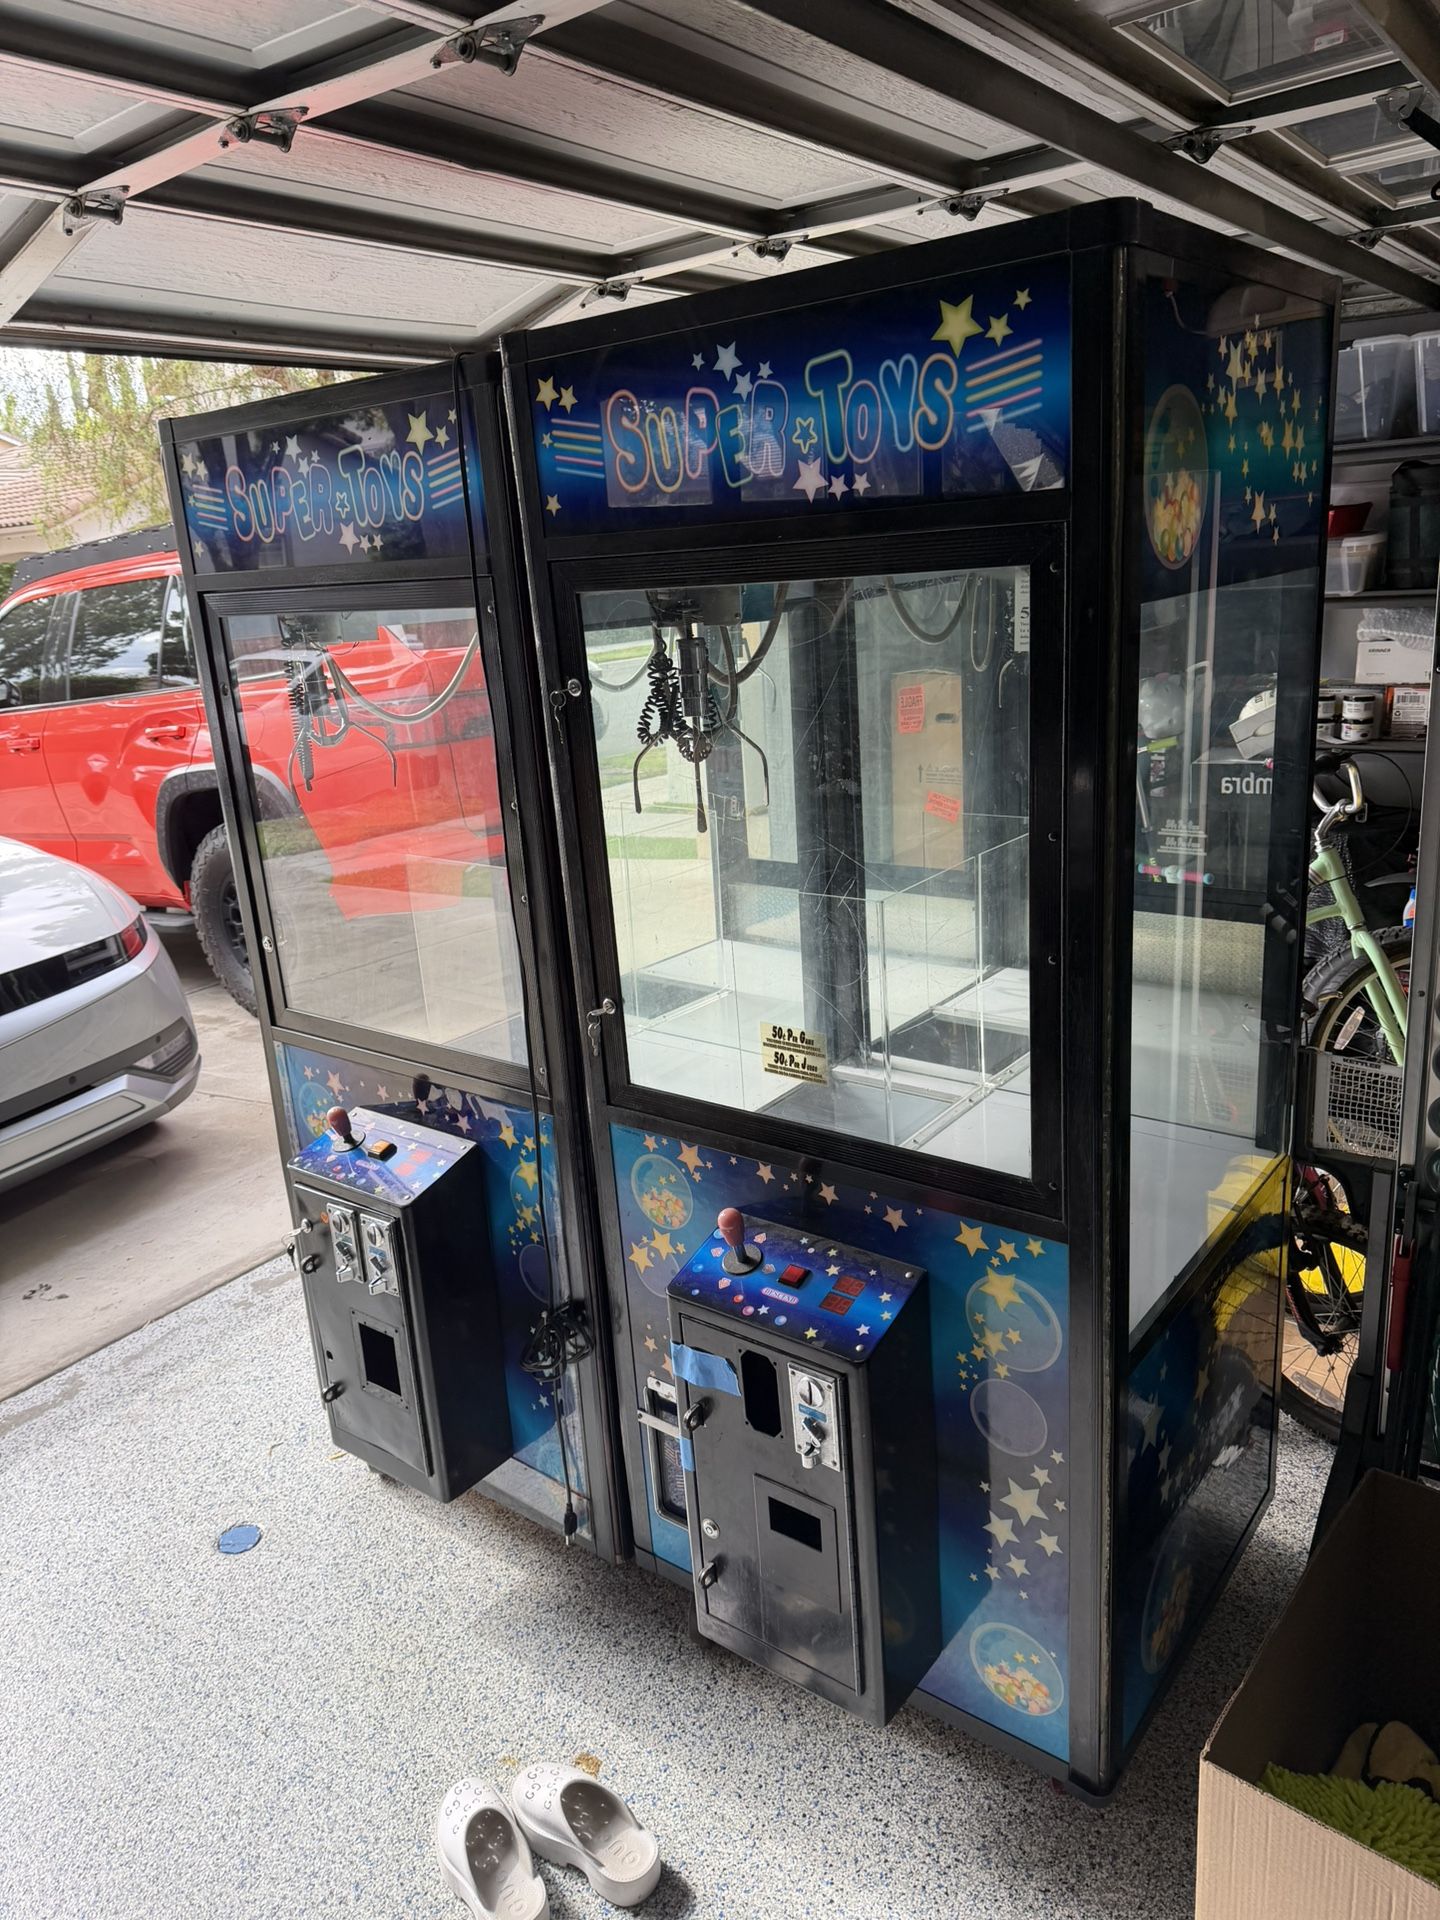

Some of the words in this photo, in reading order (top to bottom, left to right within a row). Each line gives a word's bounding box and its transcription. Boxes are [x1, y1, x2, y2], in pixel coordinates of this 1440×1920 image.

[605, 379, 790, 493] SUPER
[804, 348, 958, 465] TOYS
[224, 462, 334, 544] SUPER
[338, 444, 425, 528] TOYS
[1343, 1058, 1381, 1069] KETTLER
